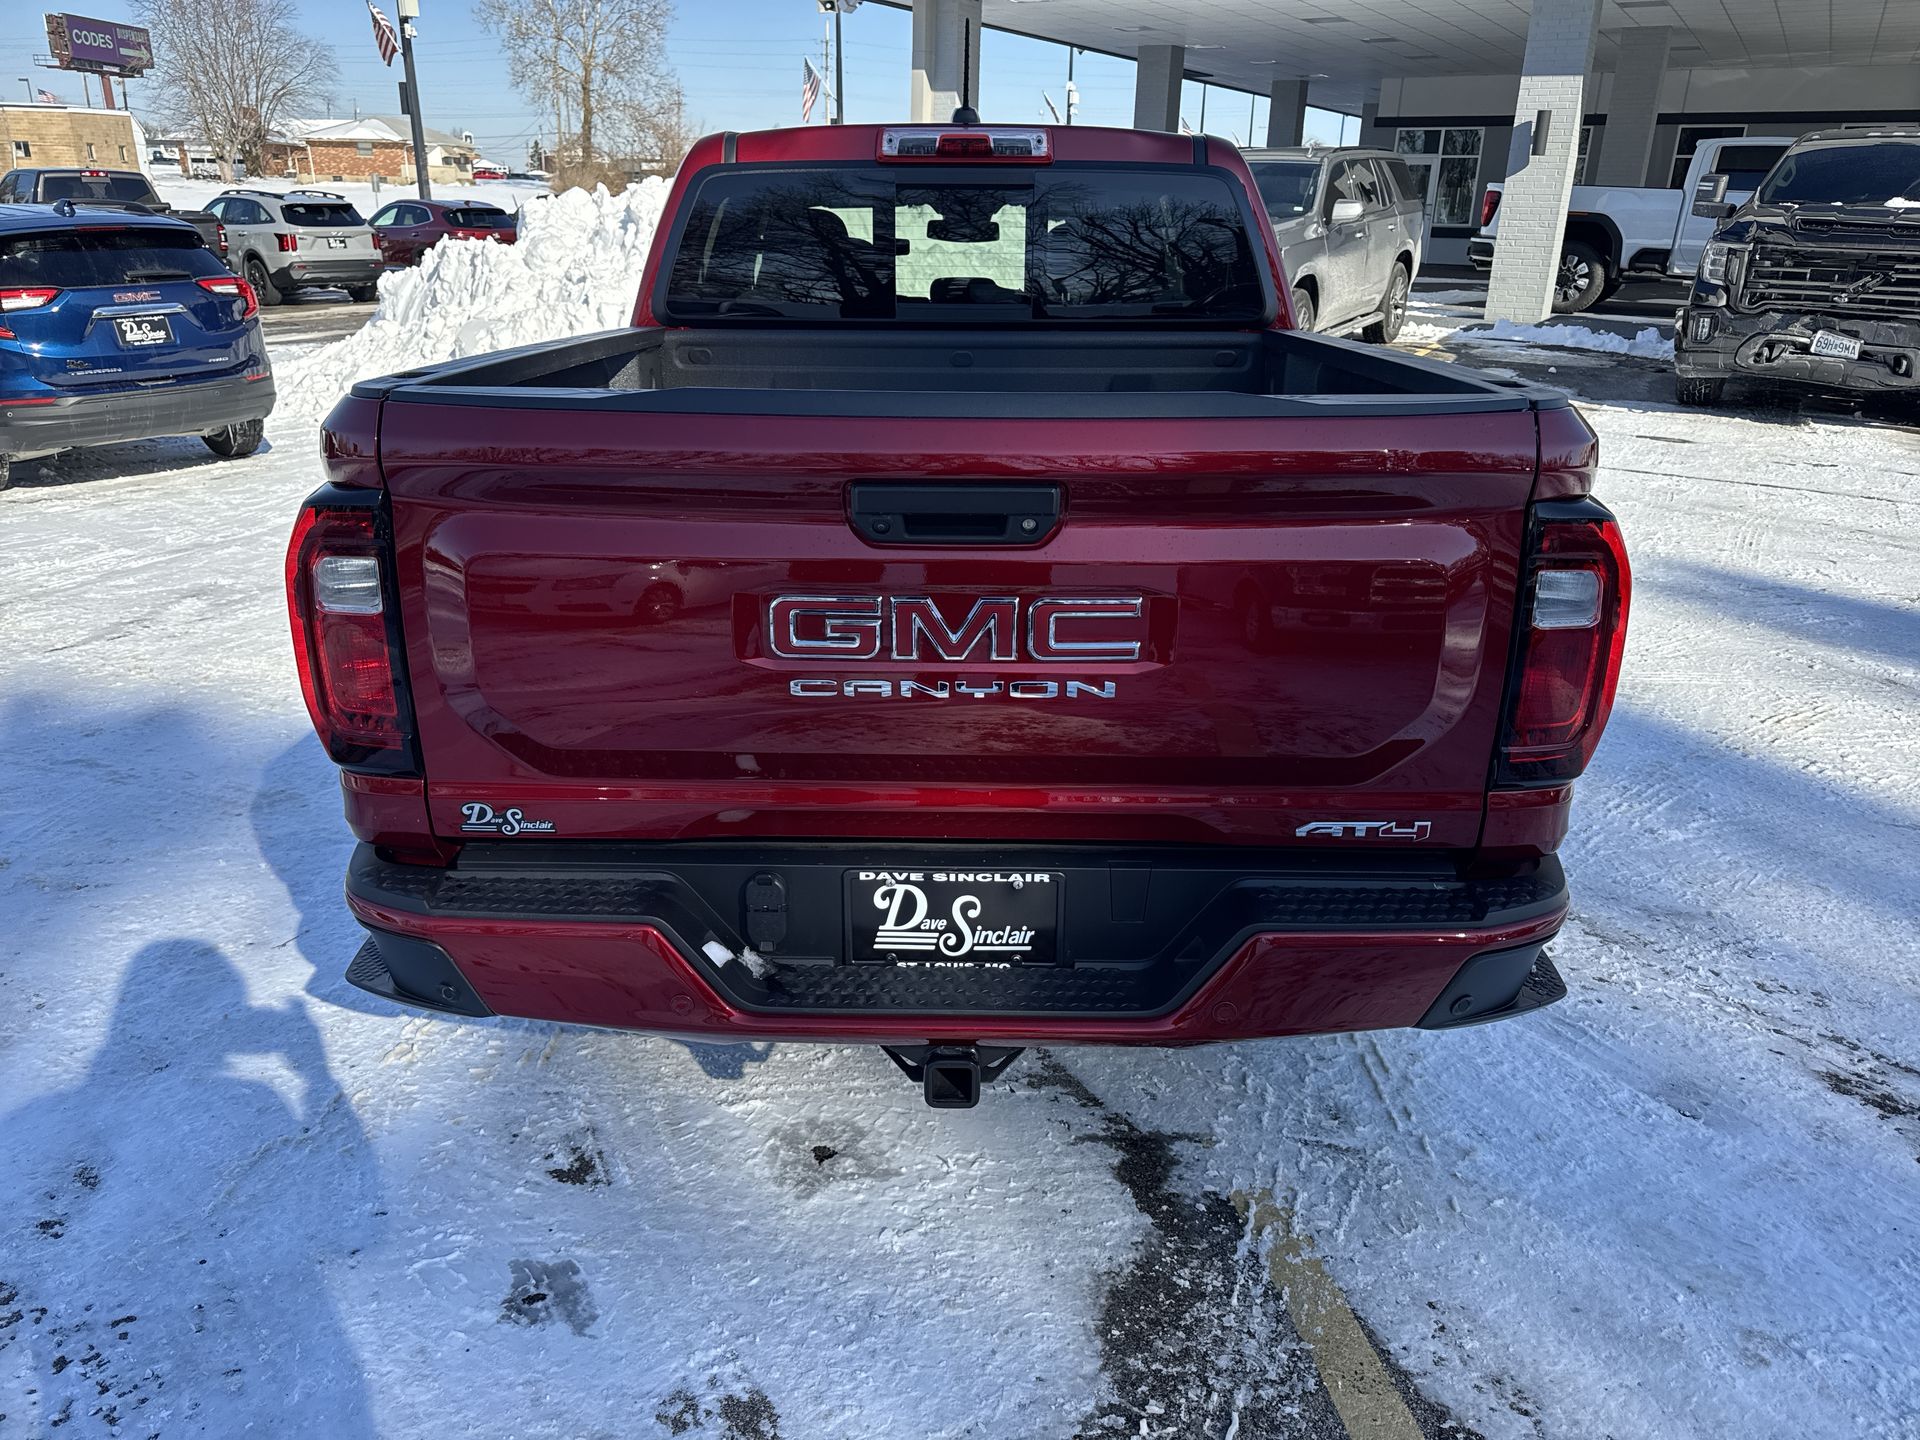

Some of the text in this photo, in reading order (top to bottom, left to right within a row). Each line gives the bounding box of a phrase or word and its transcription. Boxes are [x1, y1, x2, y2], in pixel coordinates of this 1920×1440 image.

[72, 29, 114, 49] CODES
[113, 290, 162, 303] GMC
[1816, 336, 1856, 355] 69H 9MA
[768, 595, 1143, 661] GMC
[789, 679, 1116, 698] CANYON
[461, 802, 553, 836] Dave Sinclair
[1295, 821, 1431, 842] AT4
[859, 871, 1050, 883] DAVE SINCLAIR
[873, 883, 1036, 957] Dave Sinclair
